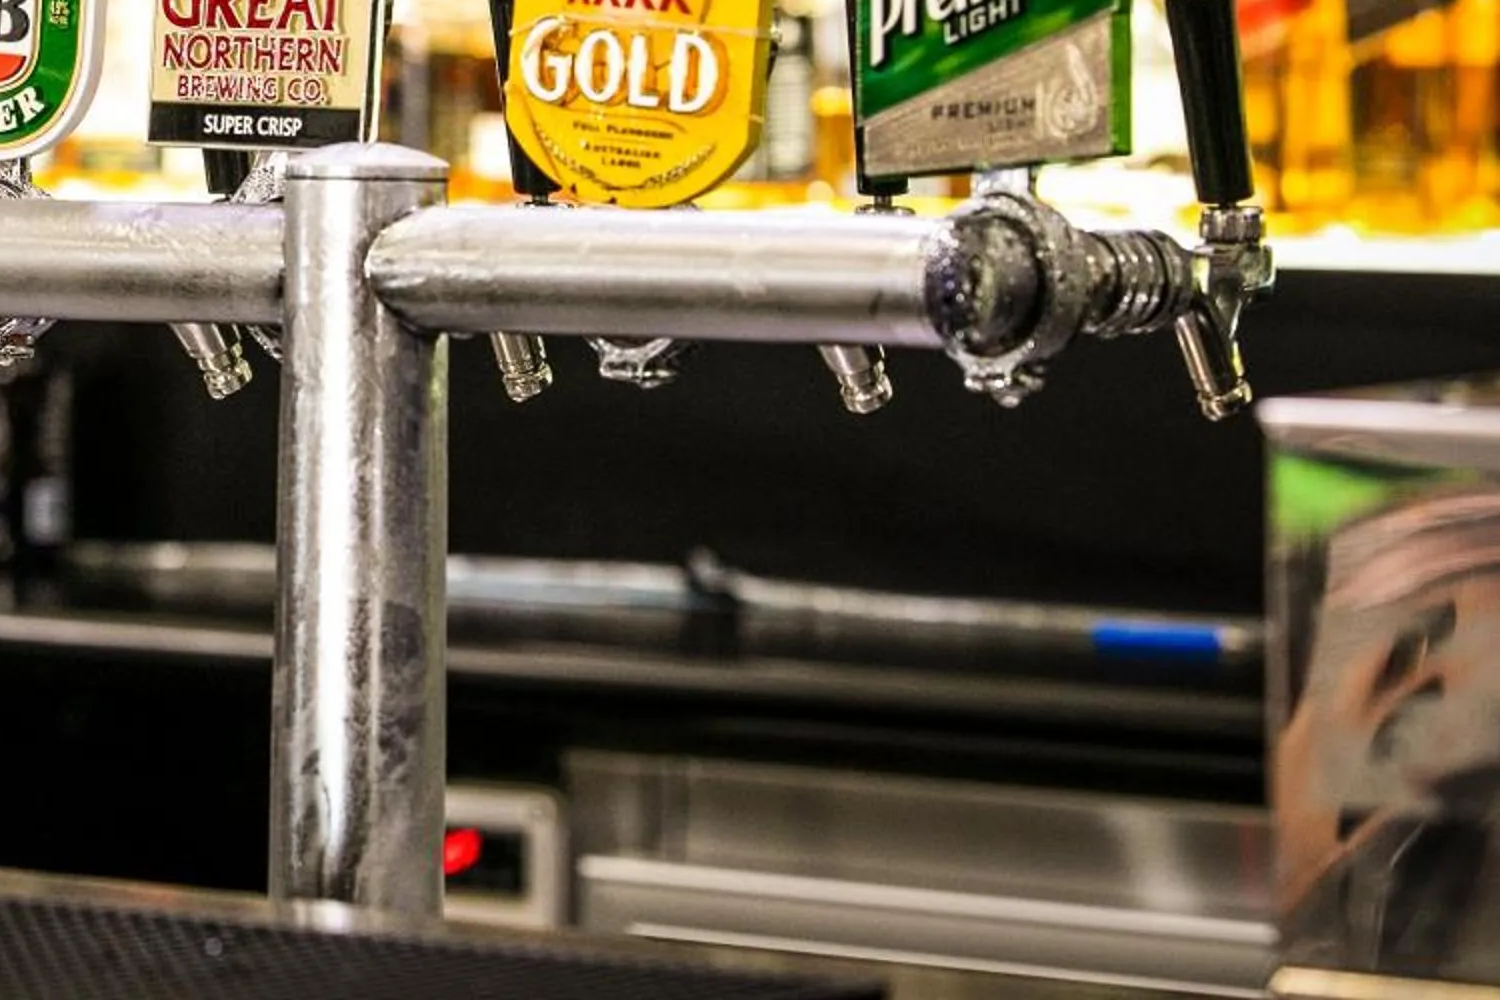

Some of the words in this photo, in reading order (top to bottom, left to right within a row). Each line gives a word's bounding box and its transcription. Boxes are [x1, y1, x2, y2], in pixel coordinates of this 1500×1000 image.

[162, 34, 346, 74] NORTHERN
[520, 16, 719, 114] GOLD
[176, 74, 278, 101] BREWING
[287, 78, 329, 103] CO.
[930, 96, 1037, 121] PREMIUM
[202, 113, 255, 137] SUPER
[256, 115, 303, 138] CRISP
